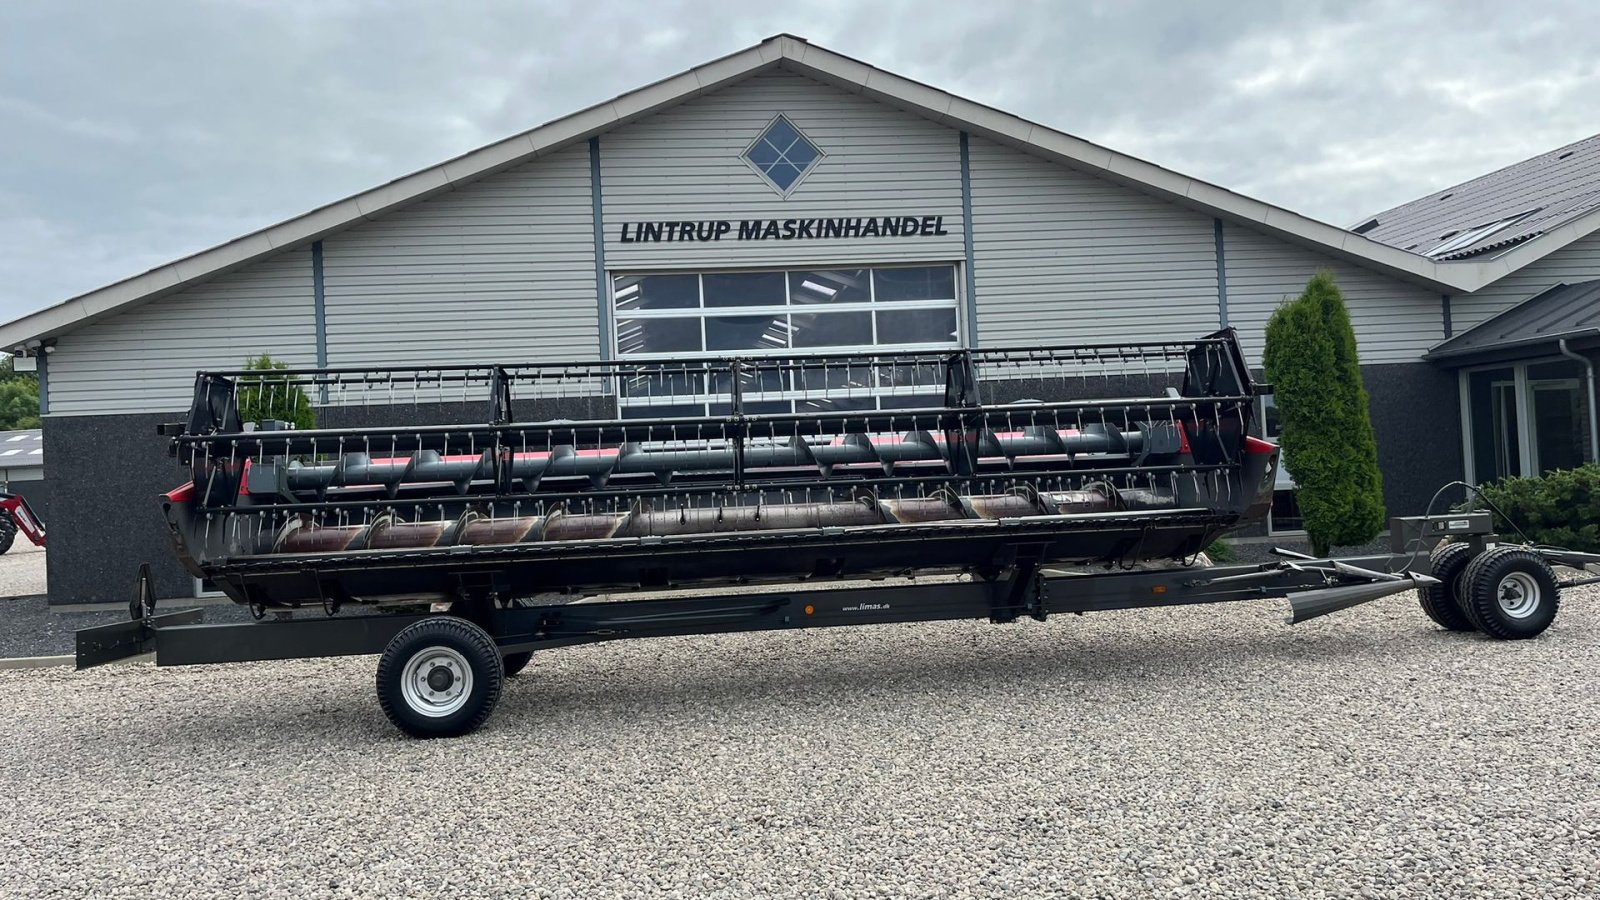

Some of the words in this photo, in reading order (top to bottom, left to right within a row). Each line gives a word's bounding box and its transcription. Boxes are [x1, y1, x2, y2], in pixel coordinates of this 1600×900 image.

[620, 220, 731, 243] LINTRUP
[738, 216, 948, 240] MASKINHANDEL
[842, 602, 890, 611] www.limas.dk
